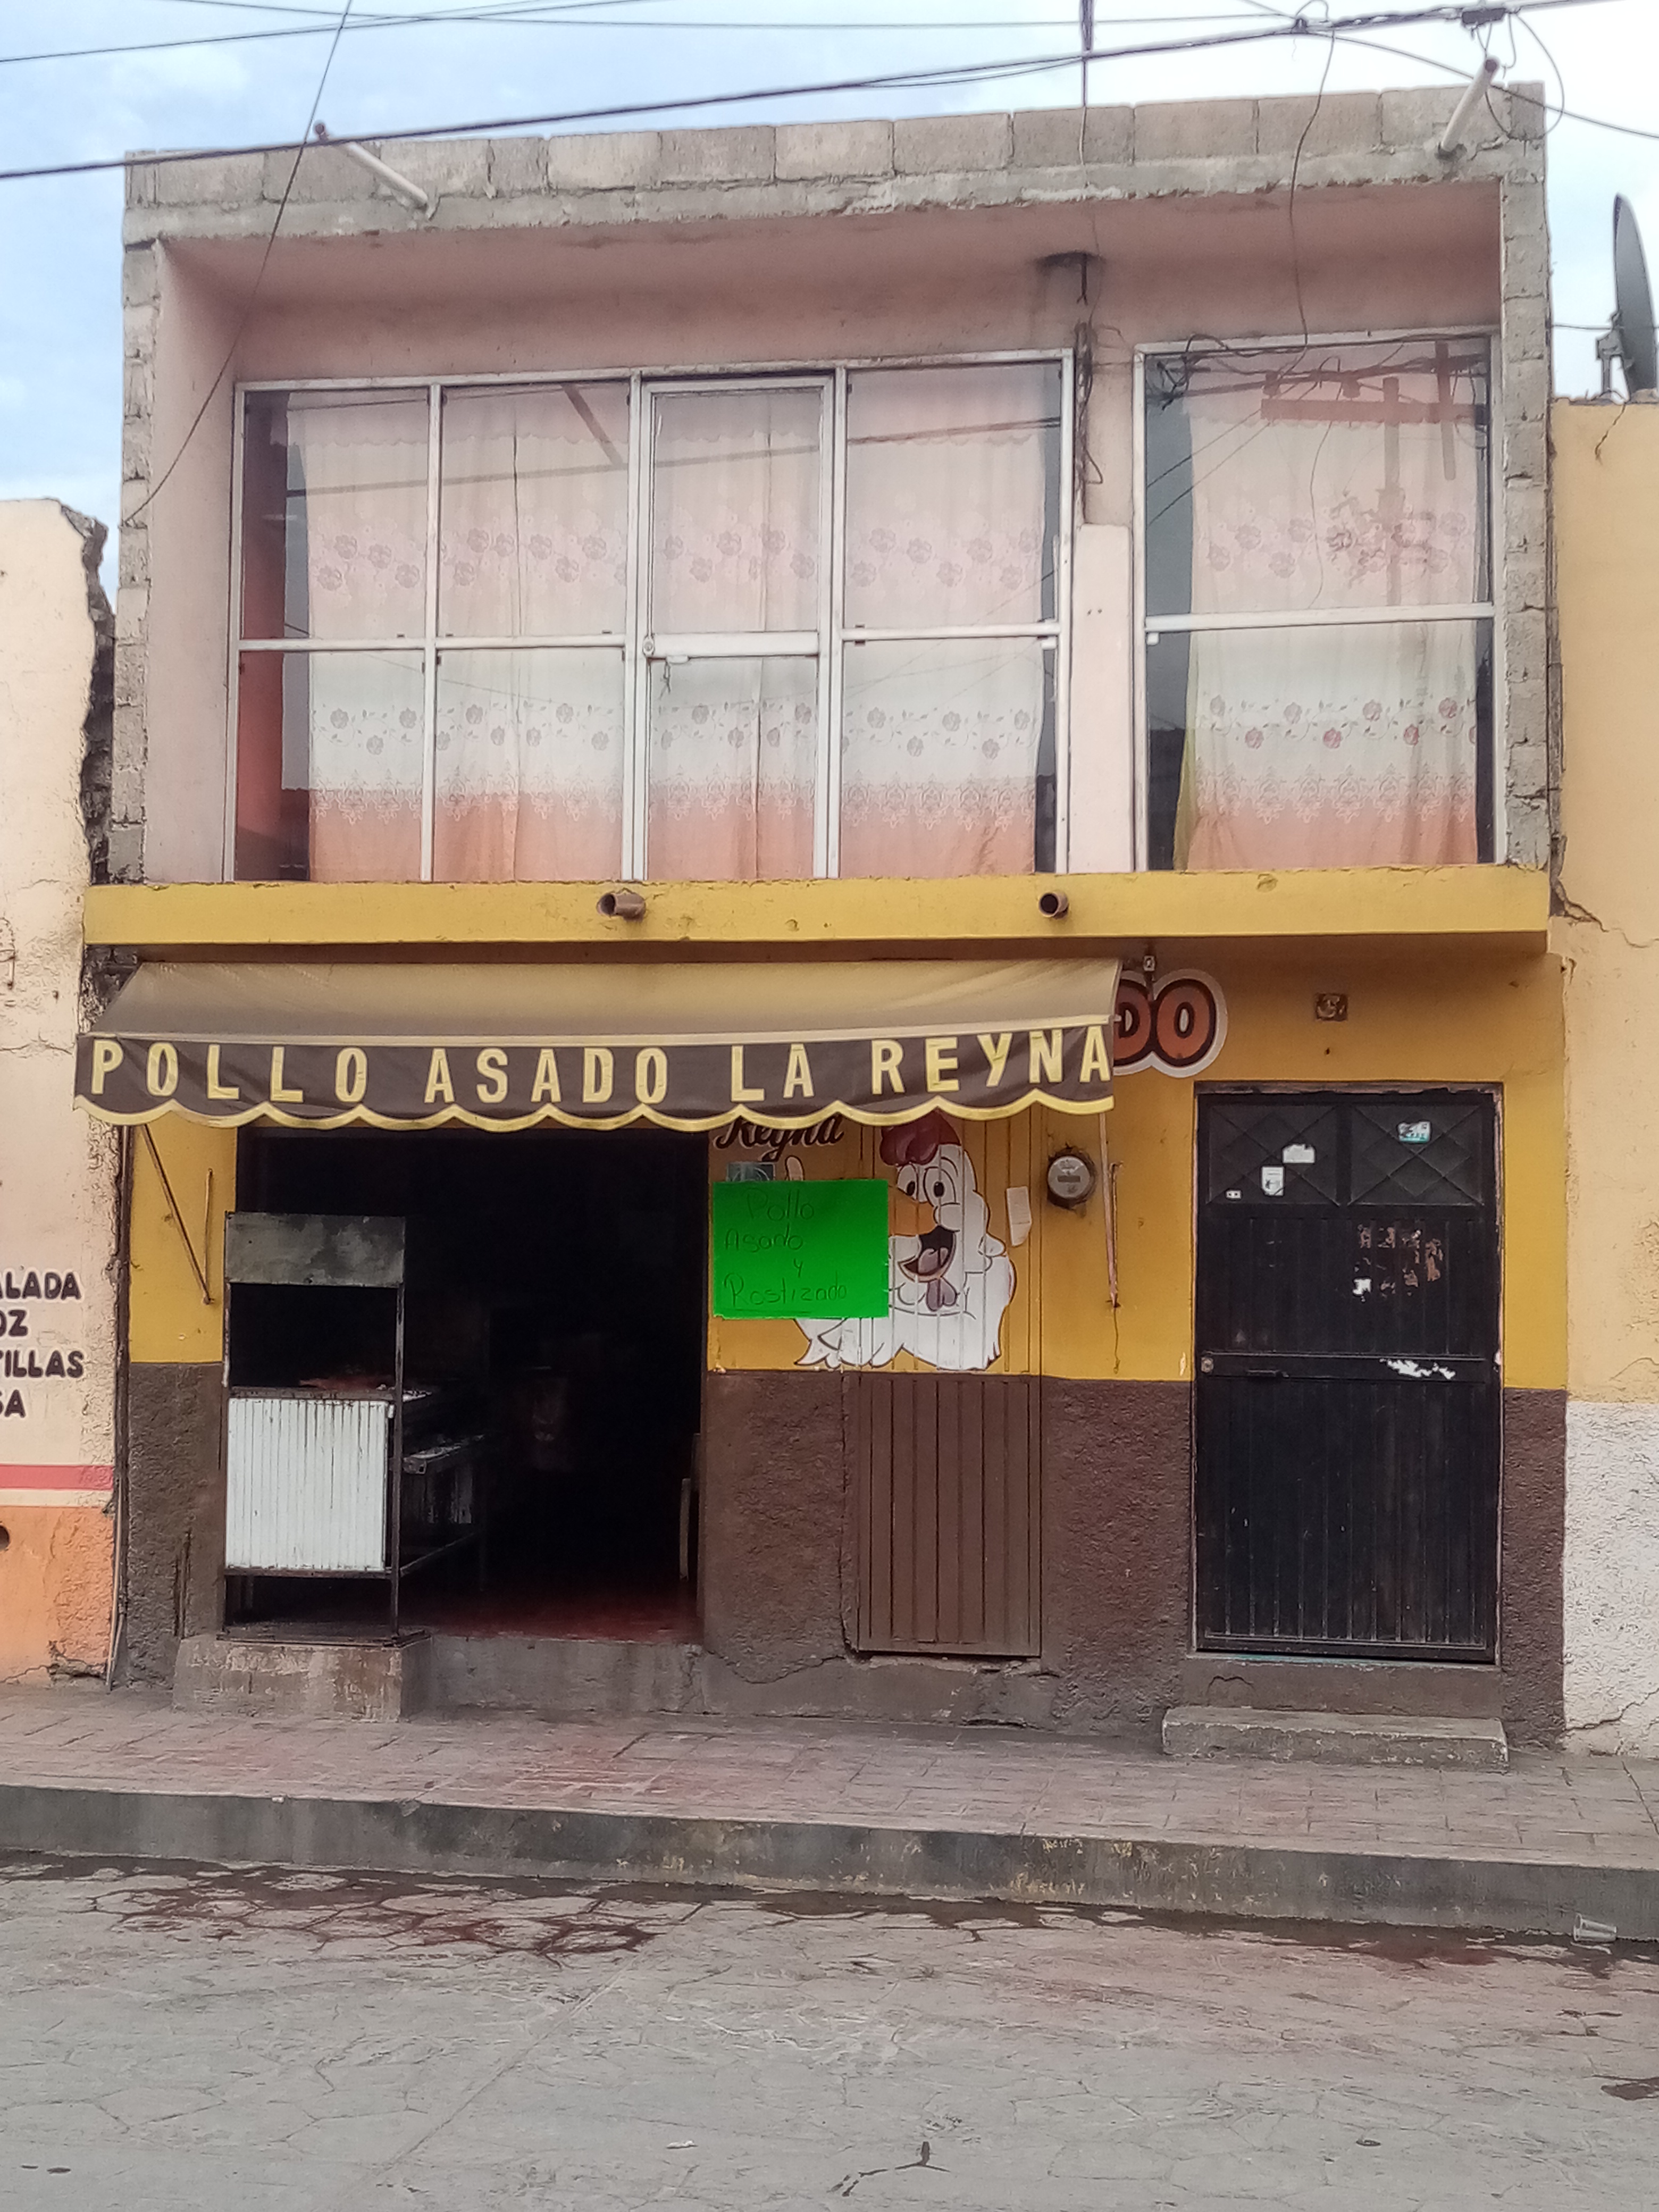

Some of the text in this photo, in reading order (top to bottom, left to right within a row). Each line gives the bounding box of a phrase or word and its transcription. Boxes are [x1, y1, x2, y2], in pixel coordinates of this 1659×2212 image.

[90, 1025, 1111, 1104] POLLO ASADO LA REYNA
[746, 1187, 815, 1221] Pollo
[725, 1222, 803, 1253] Asado
[0, 1271, 81, 1300] LADA
[723, 1270, 847, 1307] Rostizado
[0, 1349, 84, 1378] ILLAS
[0, 1389, 26, 1418] A
